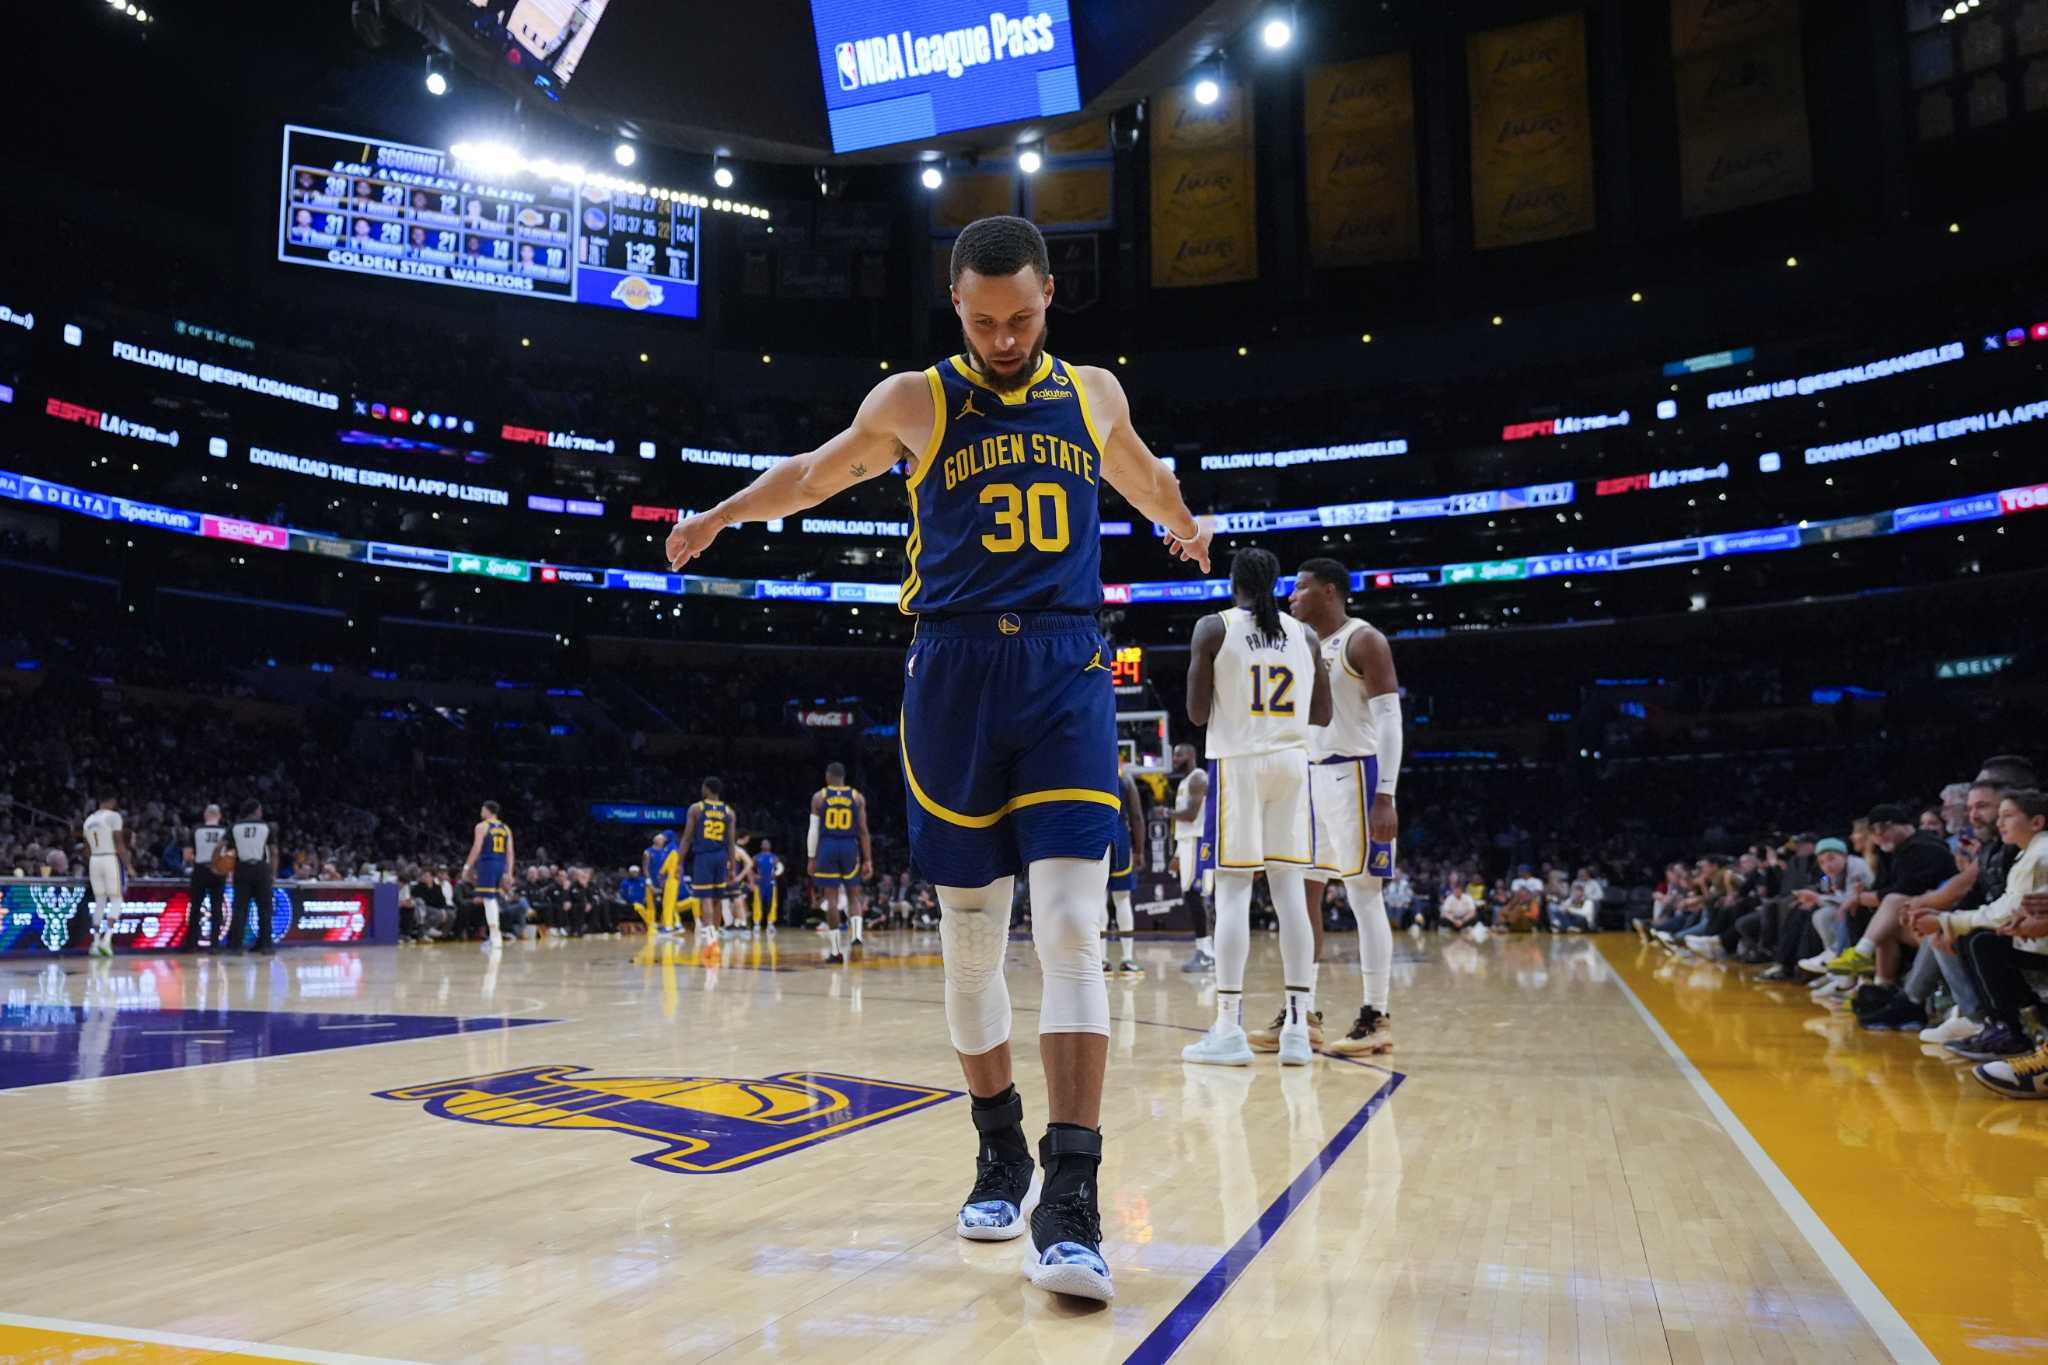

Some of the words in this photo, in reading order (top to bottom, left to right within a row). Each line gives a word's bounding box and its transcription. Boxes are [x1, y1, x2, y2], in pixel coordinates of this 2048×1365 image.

[855, 34, 906, 86] NBA
[903, 25, 991, 79] League
[989, 12, 1055, 60] Pass
[625, 241, 656, 266] 1:32
[328, 249, 398, 272] GOLDEN
[399, 259, 446, 278] STATE
[450, 266, 534, 291] WARRIORS
[113, 340, 176, 371] FOLLOW
[176, 357, 199, 377] US
[1032, 388, 1073, 400] Rakuten
[1707, 384, 1772, 409] FOLLOW
[1772, 379, 1797, 398] US
[46, 397, 101, 429] ESPN
[501, 424, 549, 446] ESPN
[1502, 420, 1555, 441] ESPN
[1804, 432, 1900, 465] DOWNLOAD
[1900, 425, 1936, 446] THE
[1937, 413, 1985, 440] ESPN
[1987, 410, 2011, 429] LA
[681, 447, 732, 466] FOLLOW
[732, 453, 751, 469] US
[943, 433, 1026, 490] GOLDEN
[1031, 433, 1095, 486] STATE
[1201, 455, 1254, 470] FOLLOW
[1254, 454, 1274, 467] US
[250, 446, 330, 478] DOWNLOAD
[329, 463, 358, 484] THE
[358, 470, 398, 490] ESPN
[459, 485, 508, 506] LISTEN
[1596, 474, 1649, 496] ESPN
[48, 487, 104, 513] DELTA
[1459, 496, 1487, 512] 124
[119, 502, 191, 530] Spectrum
[631, 504, 678, 523] ESPN
[979, 482, 1070, 553] 30
[1229, 516, 1259, 530] 117
[802, 518, 875, 535] DOWNLOAD
[875, 521, 899, 536] THE
[1550, 554, 1608, 571] DELTA
[558, 570, 594, 582] TOYOTA
[764, 582, 826, 599] Spectrum
[1245, 633, 1289, 653] PRINCE
[1110, 660, 1140, 685] 24
[1249, 663, 1295, 718] 12
[703, 819, 725, 842] 22
[825, 807, 852, 831] 00
